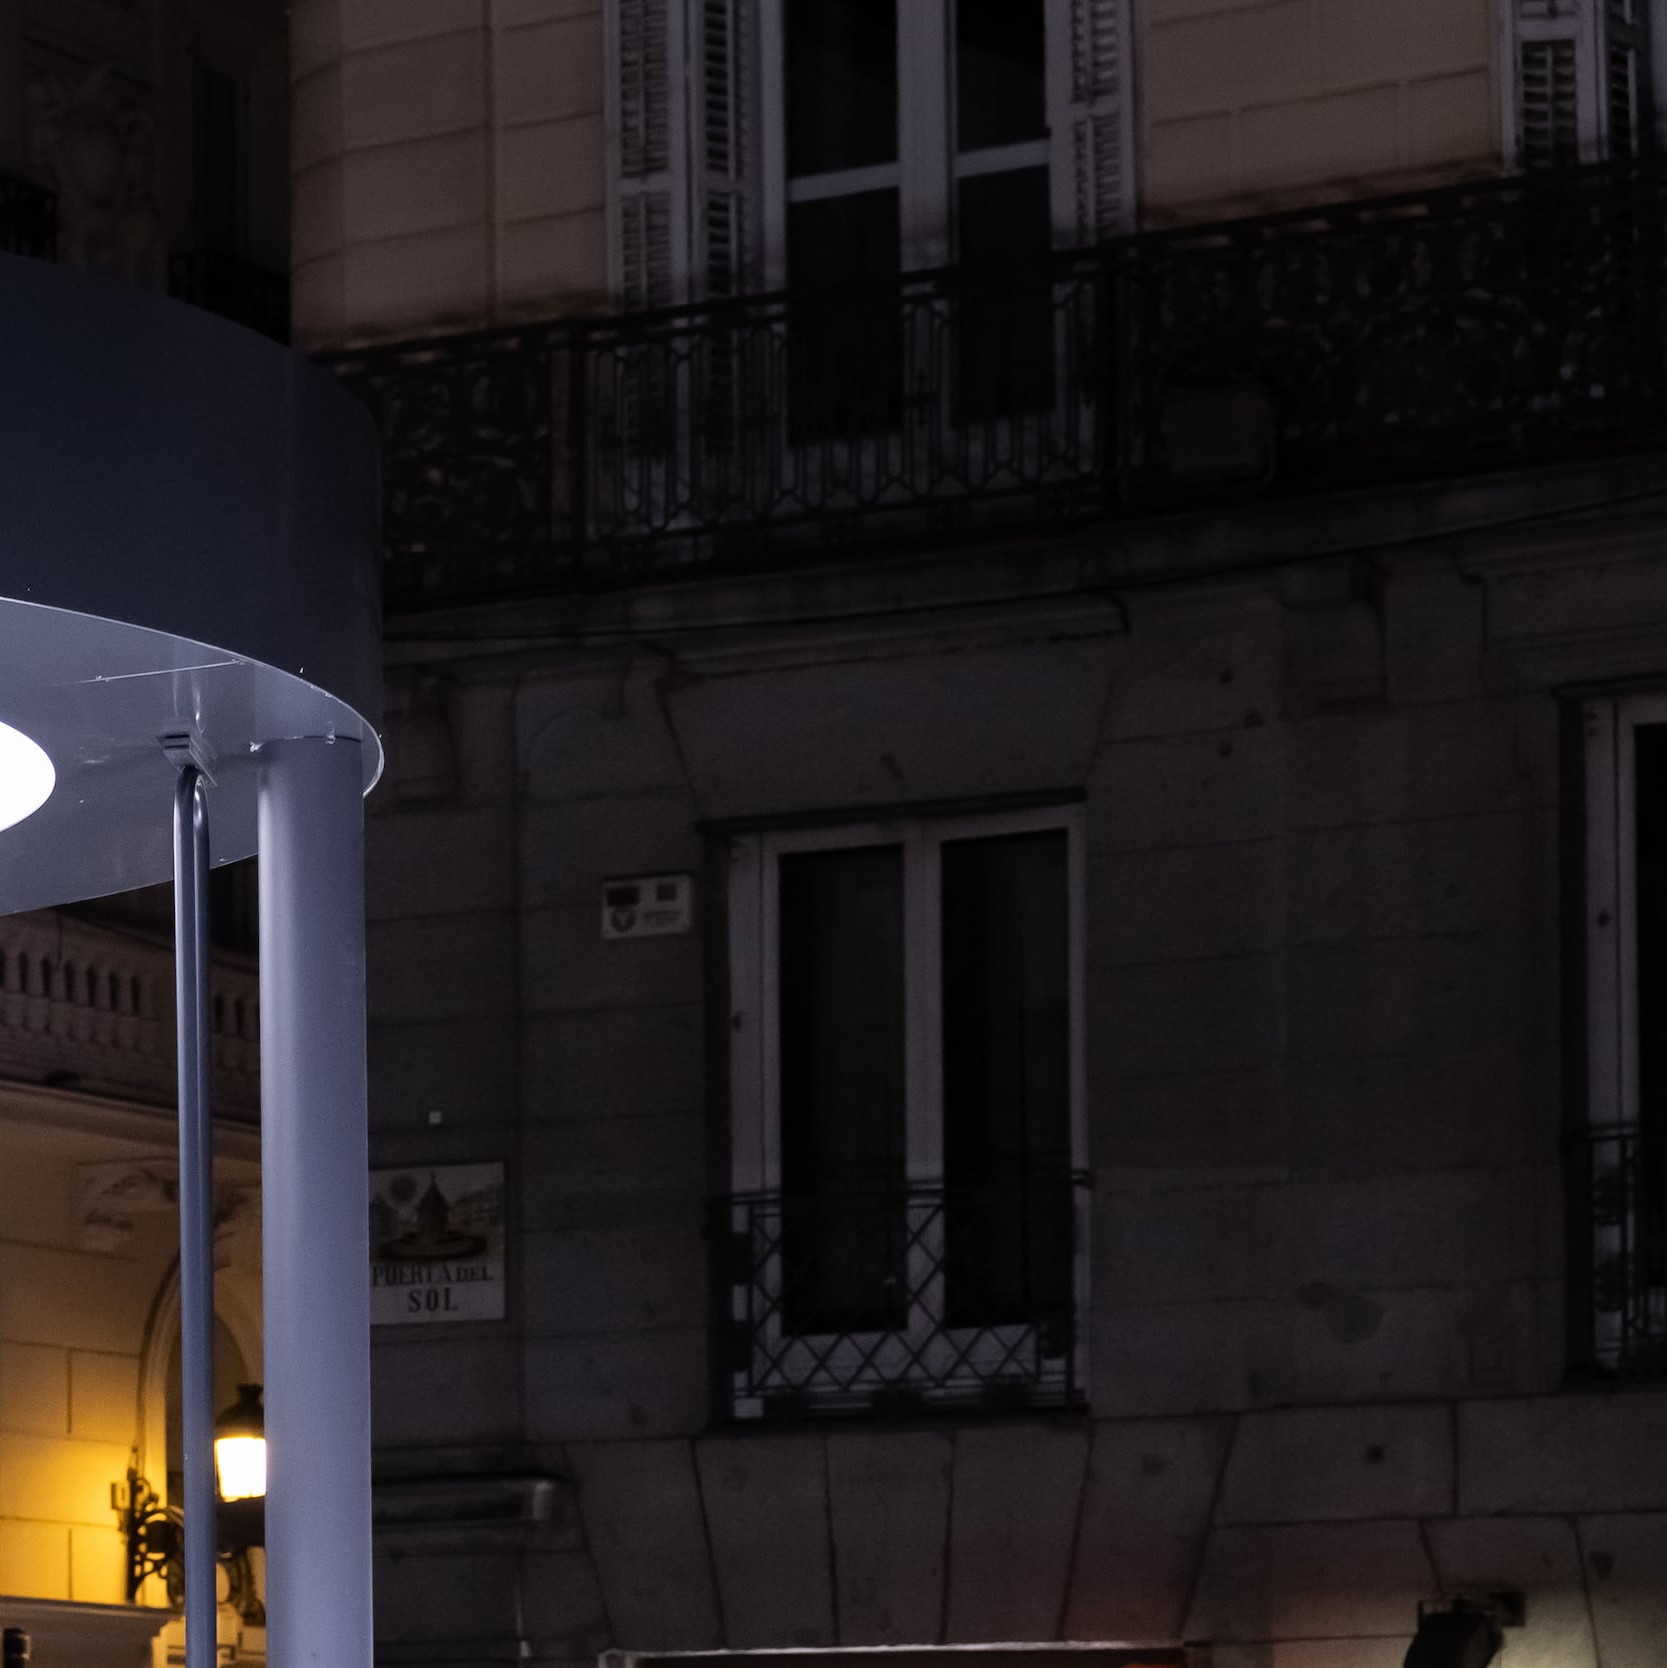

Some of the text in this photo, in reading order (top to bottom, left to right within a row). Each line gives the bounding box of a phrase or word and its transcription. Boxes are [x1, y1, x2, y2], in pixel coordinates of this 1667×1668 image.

[372, 1263, 494, 1286] PUERTA DEL
[407, 1287, 458, 1313] SOL
